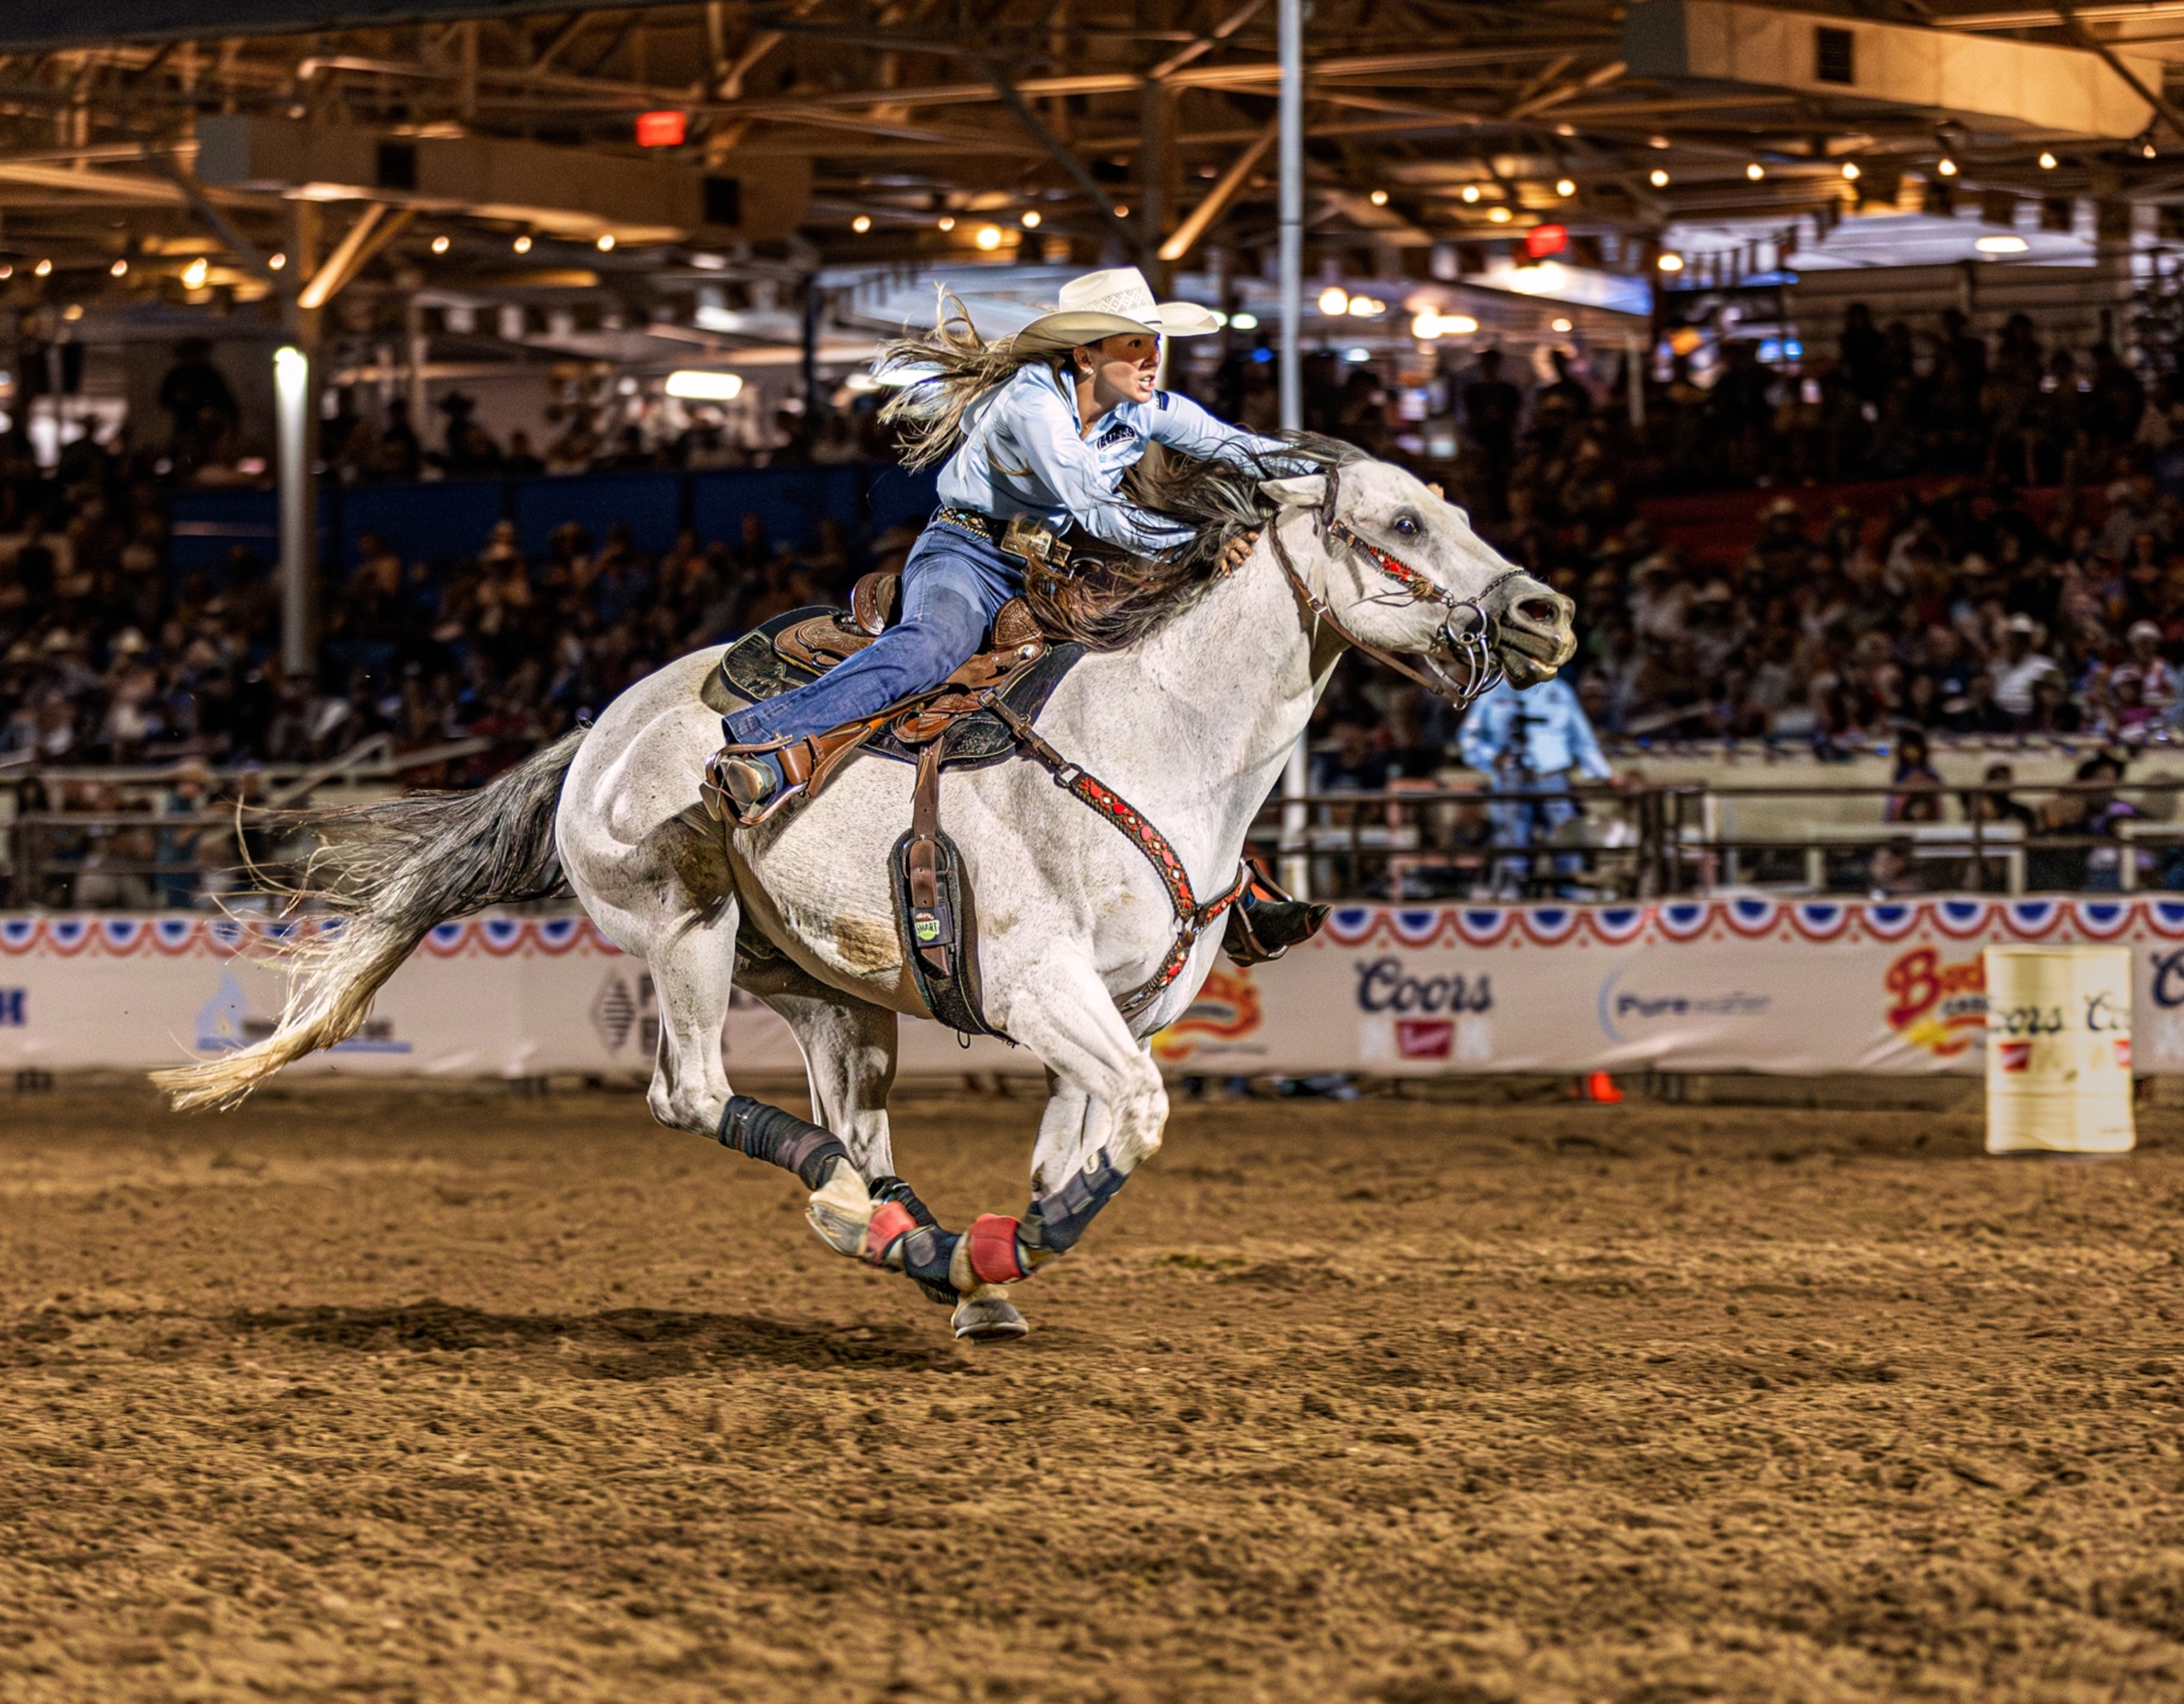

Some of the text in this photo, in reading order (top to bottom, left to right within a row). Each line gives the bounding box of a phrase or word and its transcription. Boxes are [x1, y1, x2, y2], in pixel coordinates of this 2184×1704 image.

[916, 922, 937, 933] SMART
[1354, 955, 1493, 1014] Coors
[1988, 1006, 2065, 1035] oors
